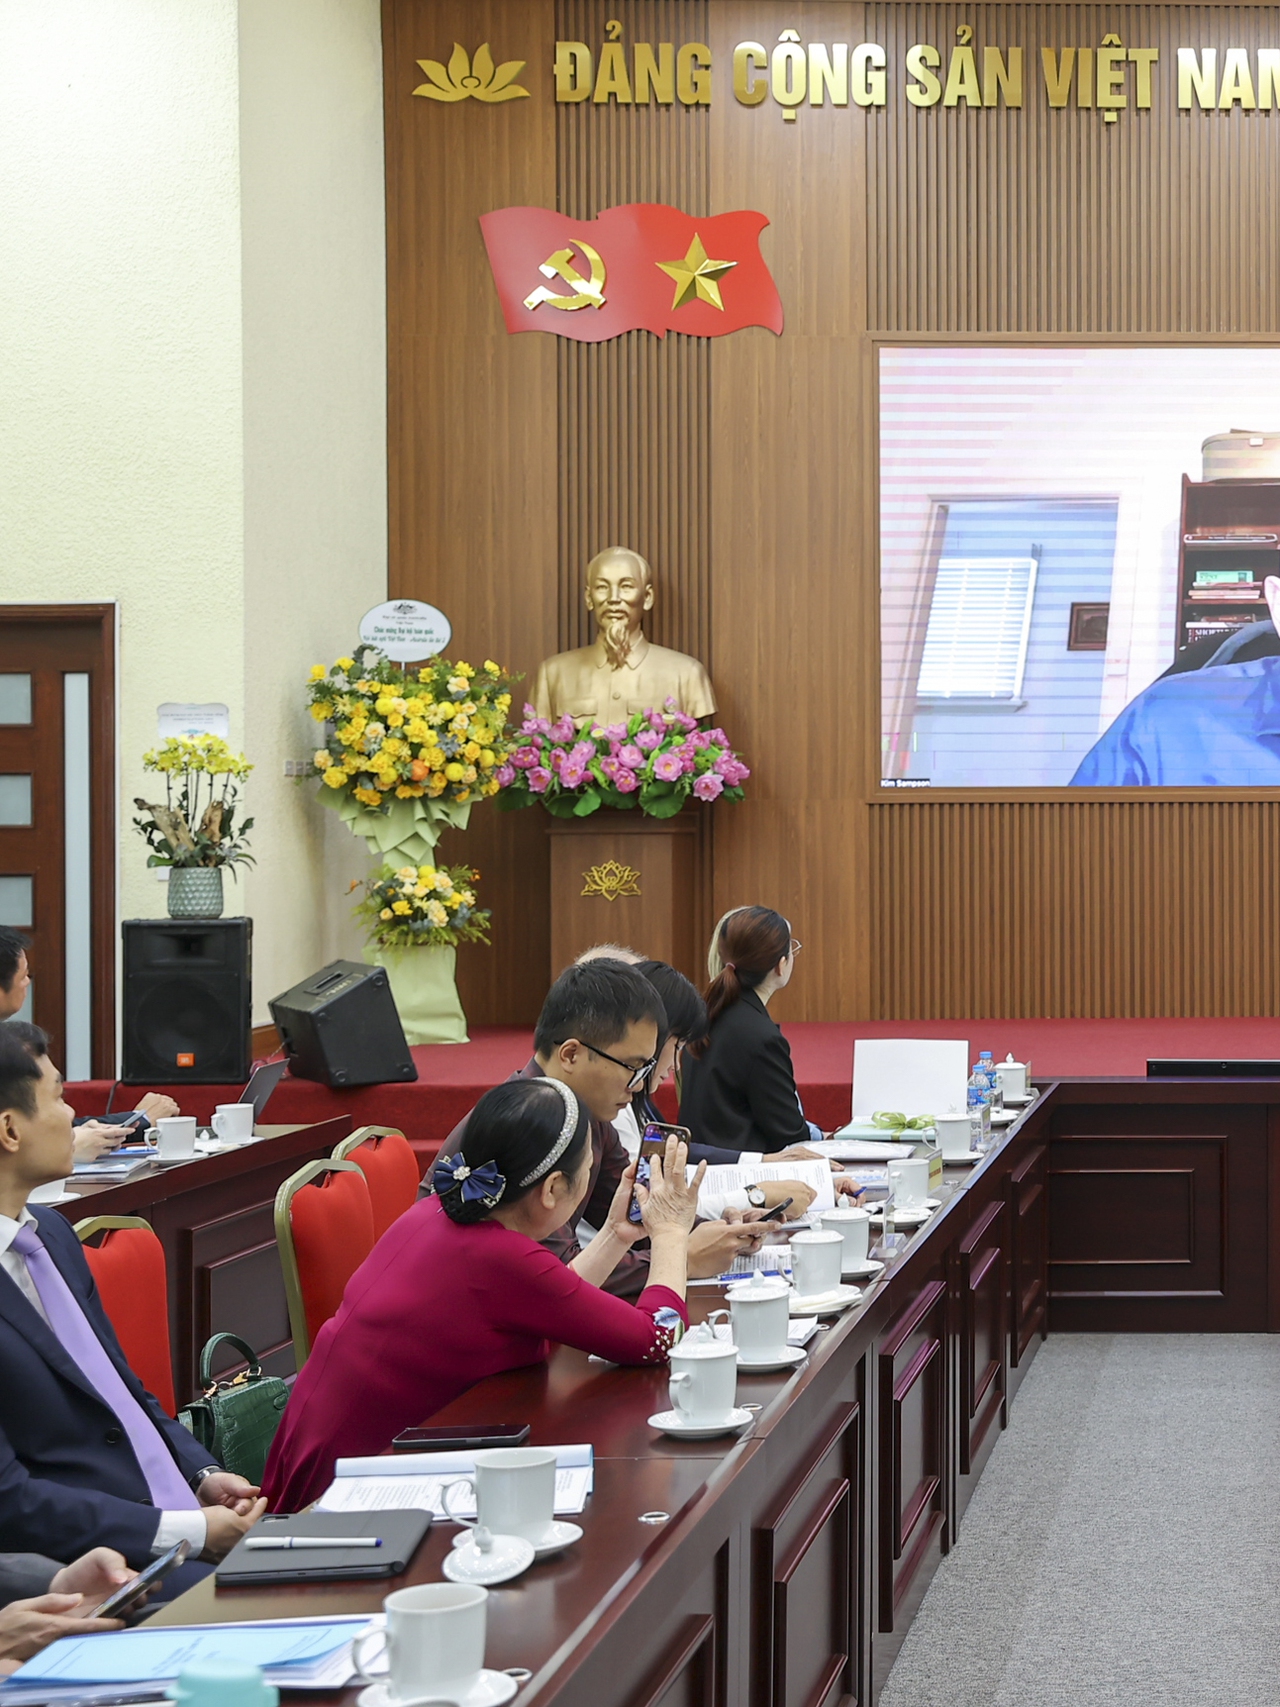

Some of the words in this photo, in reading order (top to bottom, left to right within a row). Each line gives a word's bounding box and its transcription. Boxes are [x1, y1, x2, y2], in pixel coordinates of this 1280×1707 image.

[554, 20, 711, 105] ĐẢNG
[732, 29, 887, 121] CỘNG
[905, 25, 1022, 108] SẢN
[1041, 34, 1159, 122] VIỆT
